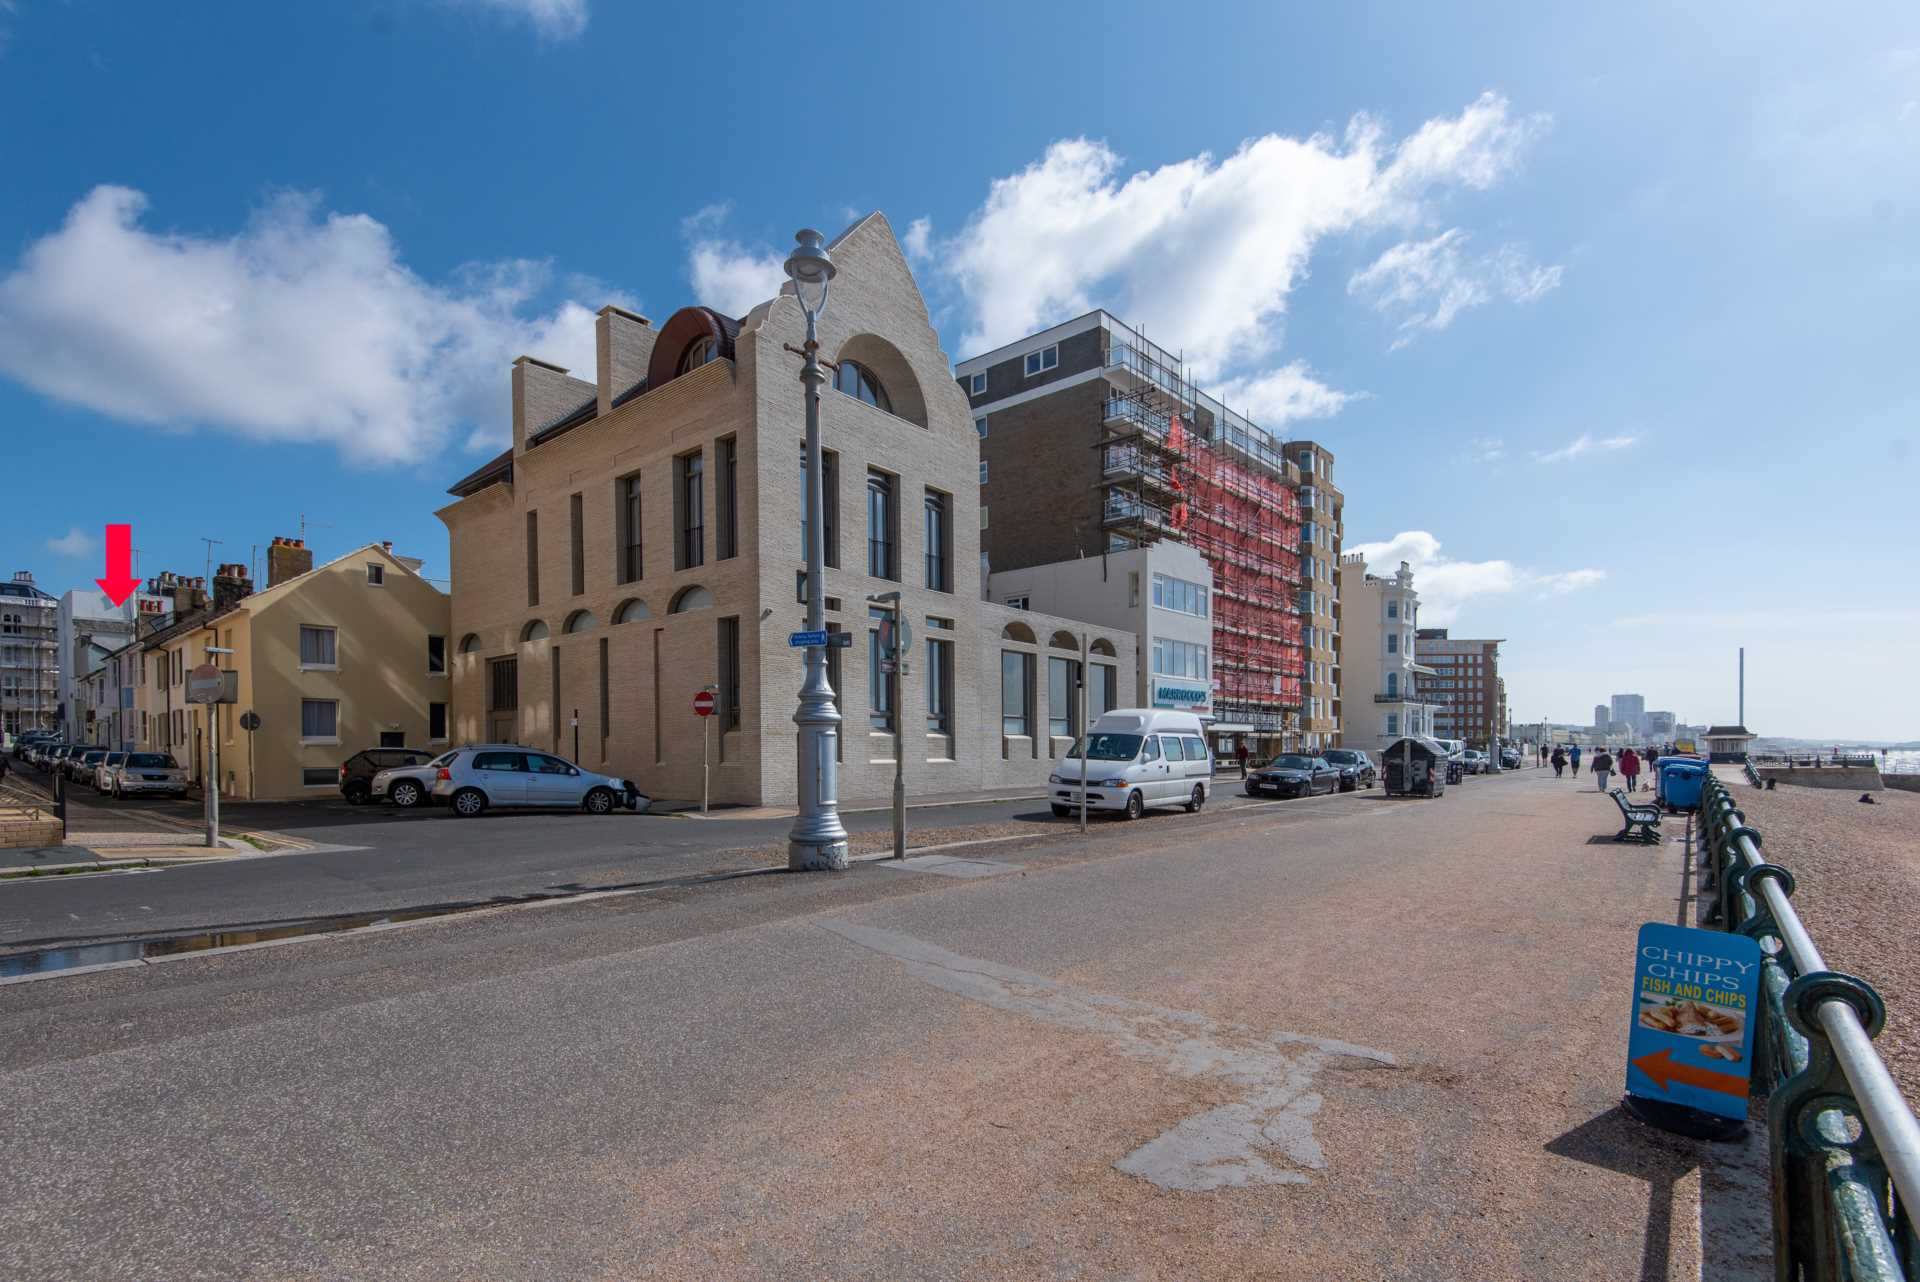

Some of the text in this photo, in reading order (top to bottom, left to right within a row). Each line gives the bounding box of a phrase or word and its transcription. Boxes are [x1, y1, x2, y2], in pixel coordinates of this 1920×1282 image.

[1642, 946, 1755, 975] CHIPPY
[1647, 963, 1740, 990] CHIPS
[1642, 975, 1747, 1009] FISH AND CHIPS
